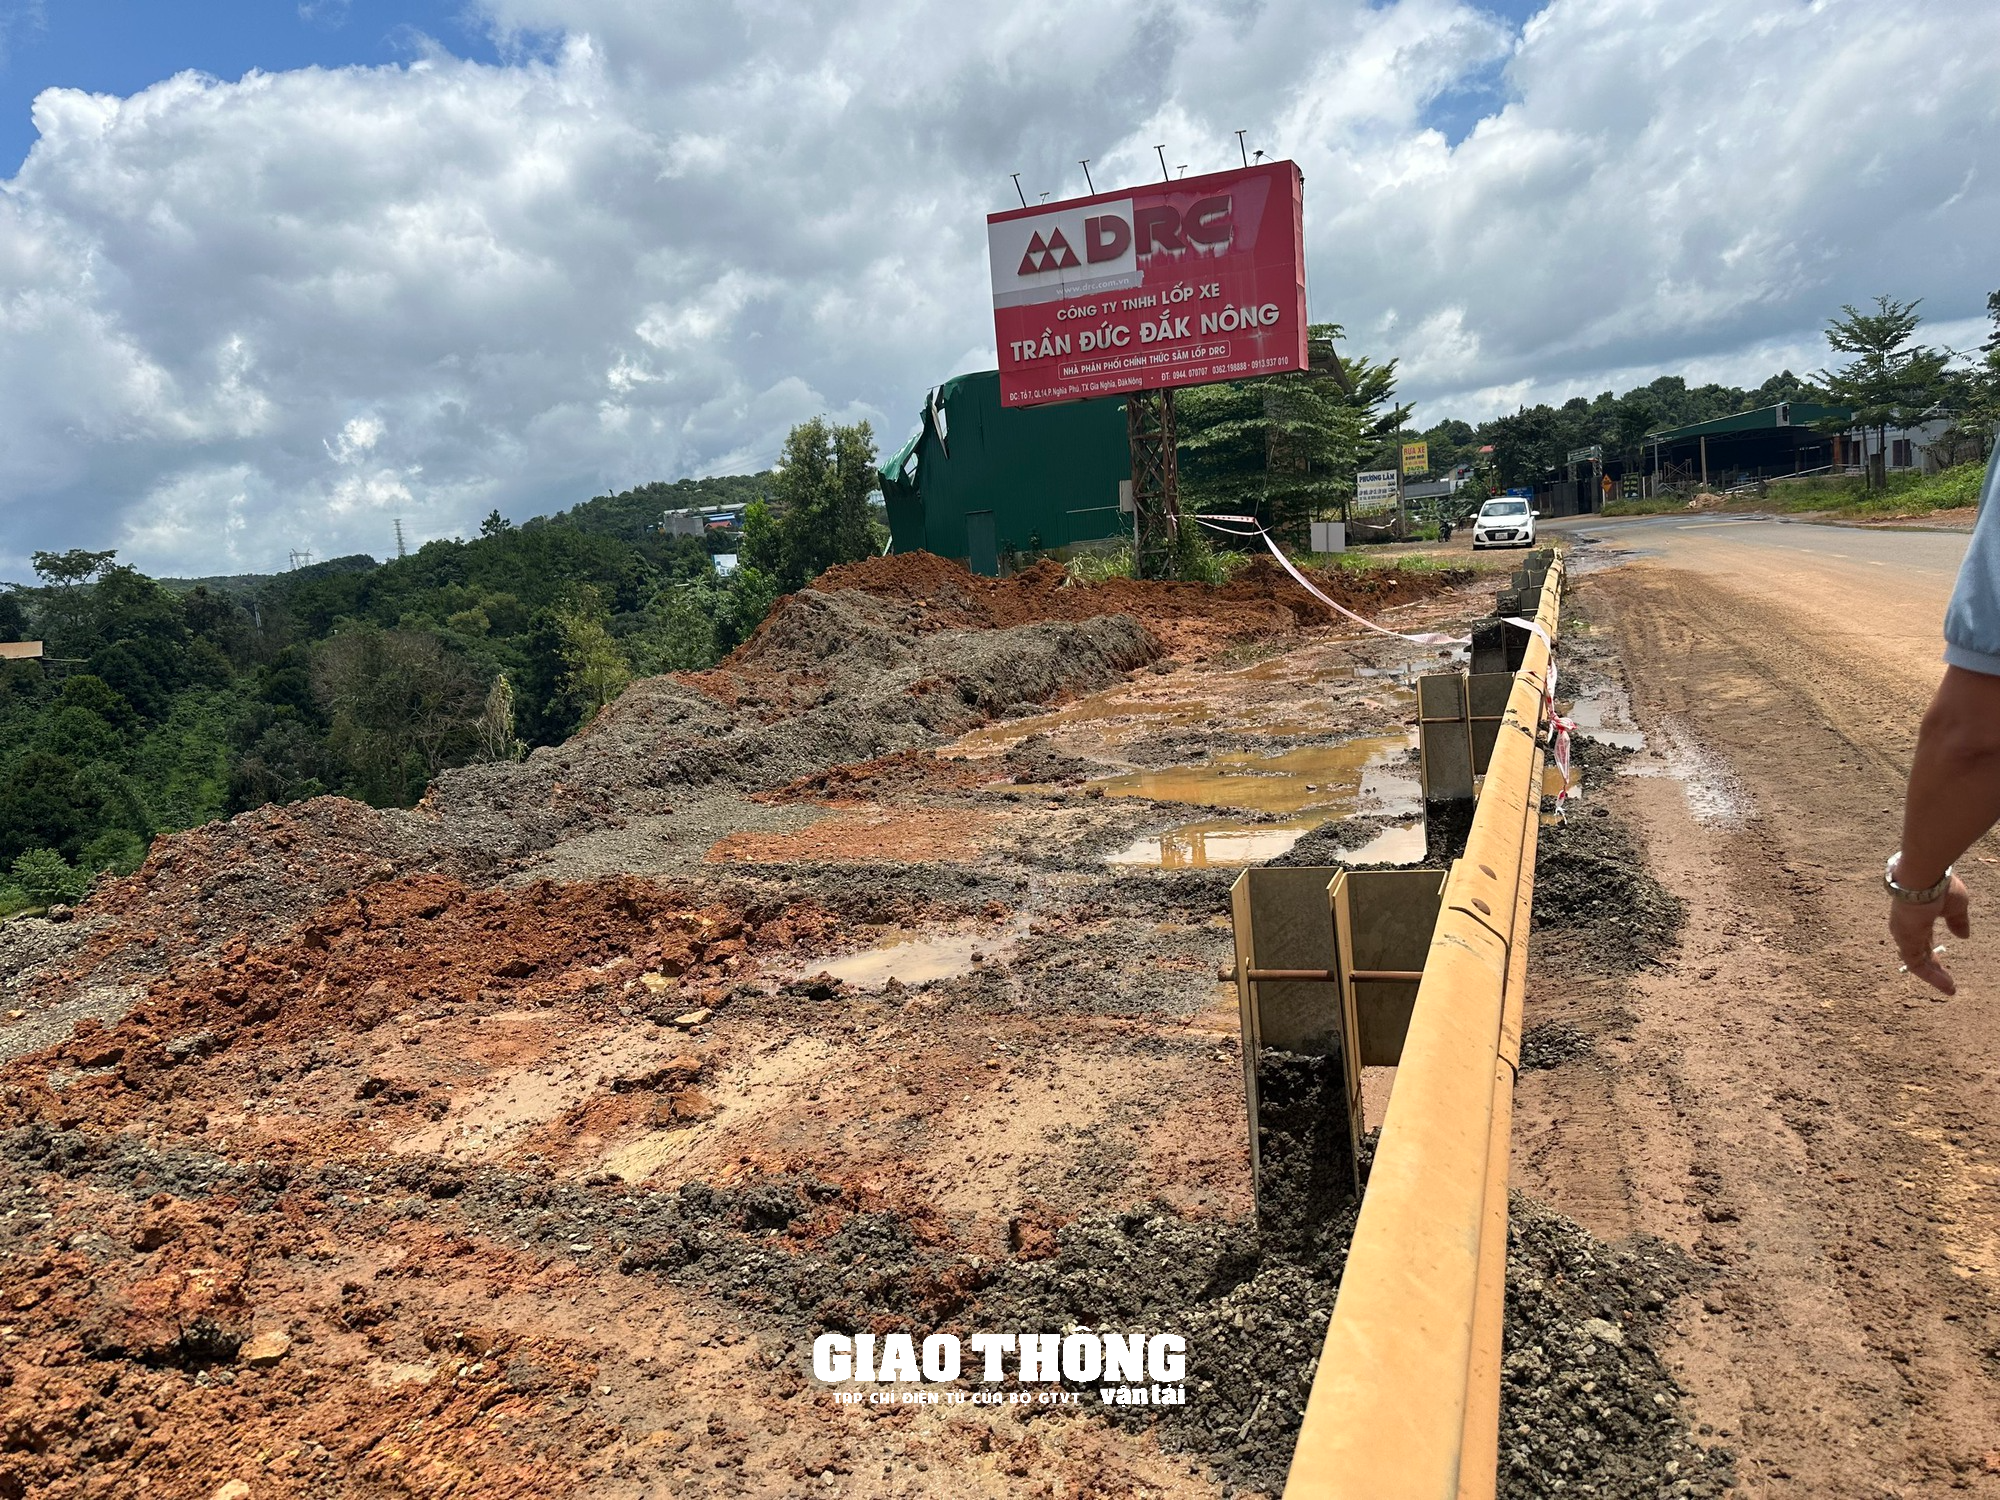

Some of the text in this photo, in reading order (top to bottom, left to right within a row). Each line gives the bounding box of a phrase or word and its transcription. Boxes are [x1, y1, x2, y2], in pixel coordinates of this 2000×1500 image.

[1084, 195, 1233, 264] DRC
[1056, 277, 1130, 296] www.drc.com.vn
[1057, 281, 1220, 321] CÔNG TY TNHH LỐP XE
[1010, 303, 1280, 362] TRẦN ĐỨC ĐẮK NÔNG
[1009, 392, 1020, 401] ĐC:
[1081, 383, 1089, 391] TX
[1090, 382, 1100, 391] Gia
[1161, 372, 1171, 381] ĐT:
[1188, 367, 1208, 378] 070707
[1277, 356, 1289, 366] 010
[1063, 344, 1226, 376] NHÀ PHÂN PHỐI CHÍNH THỨC SĂM LỐP DRC
[1417, 446, 1425, 454] XE
